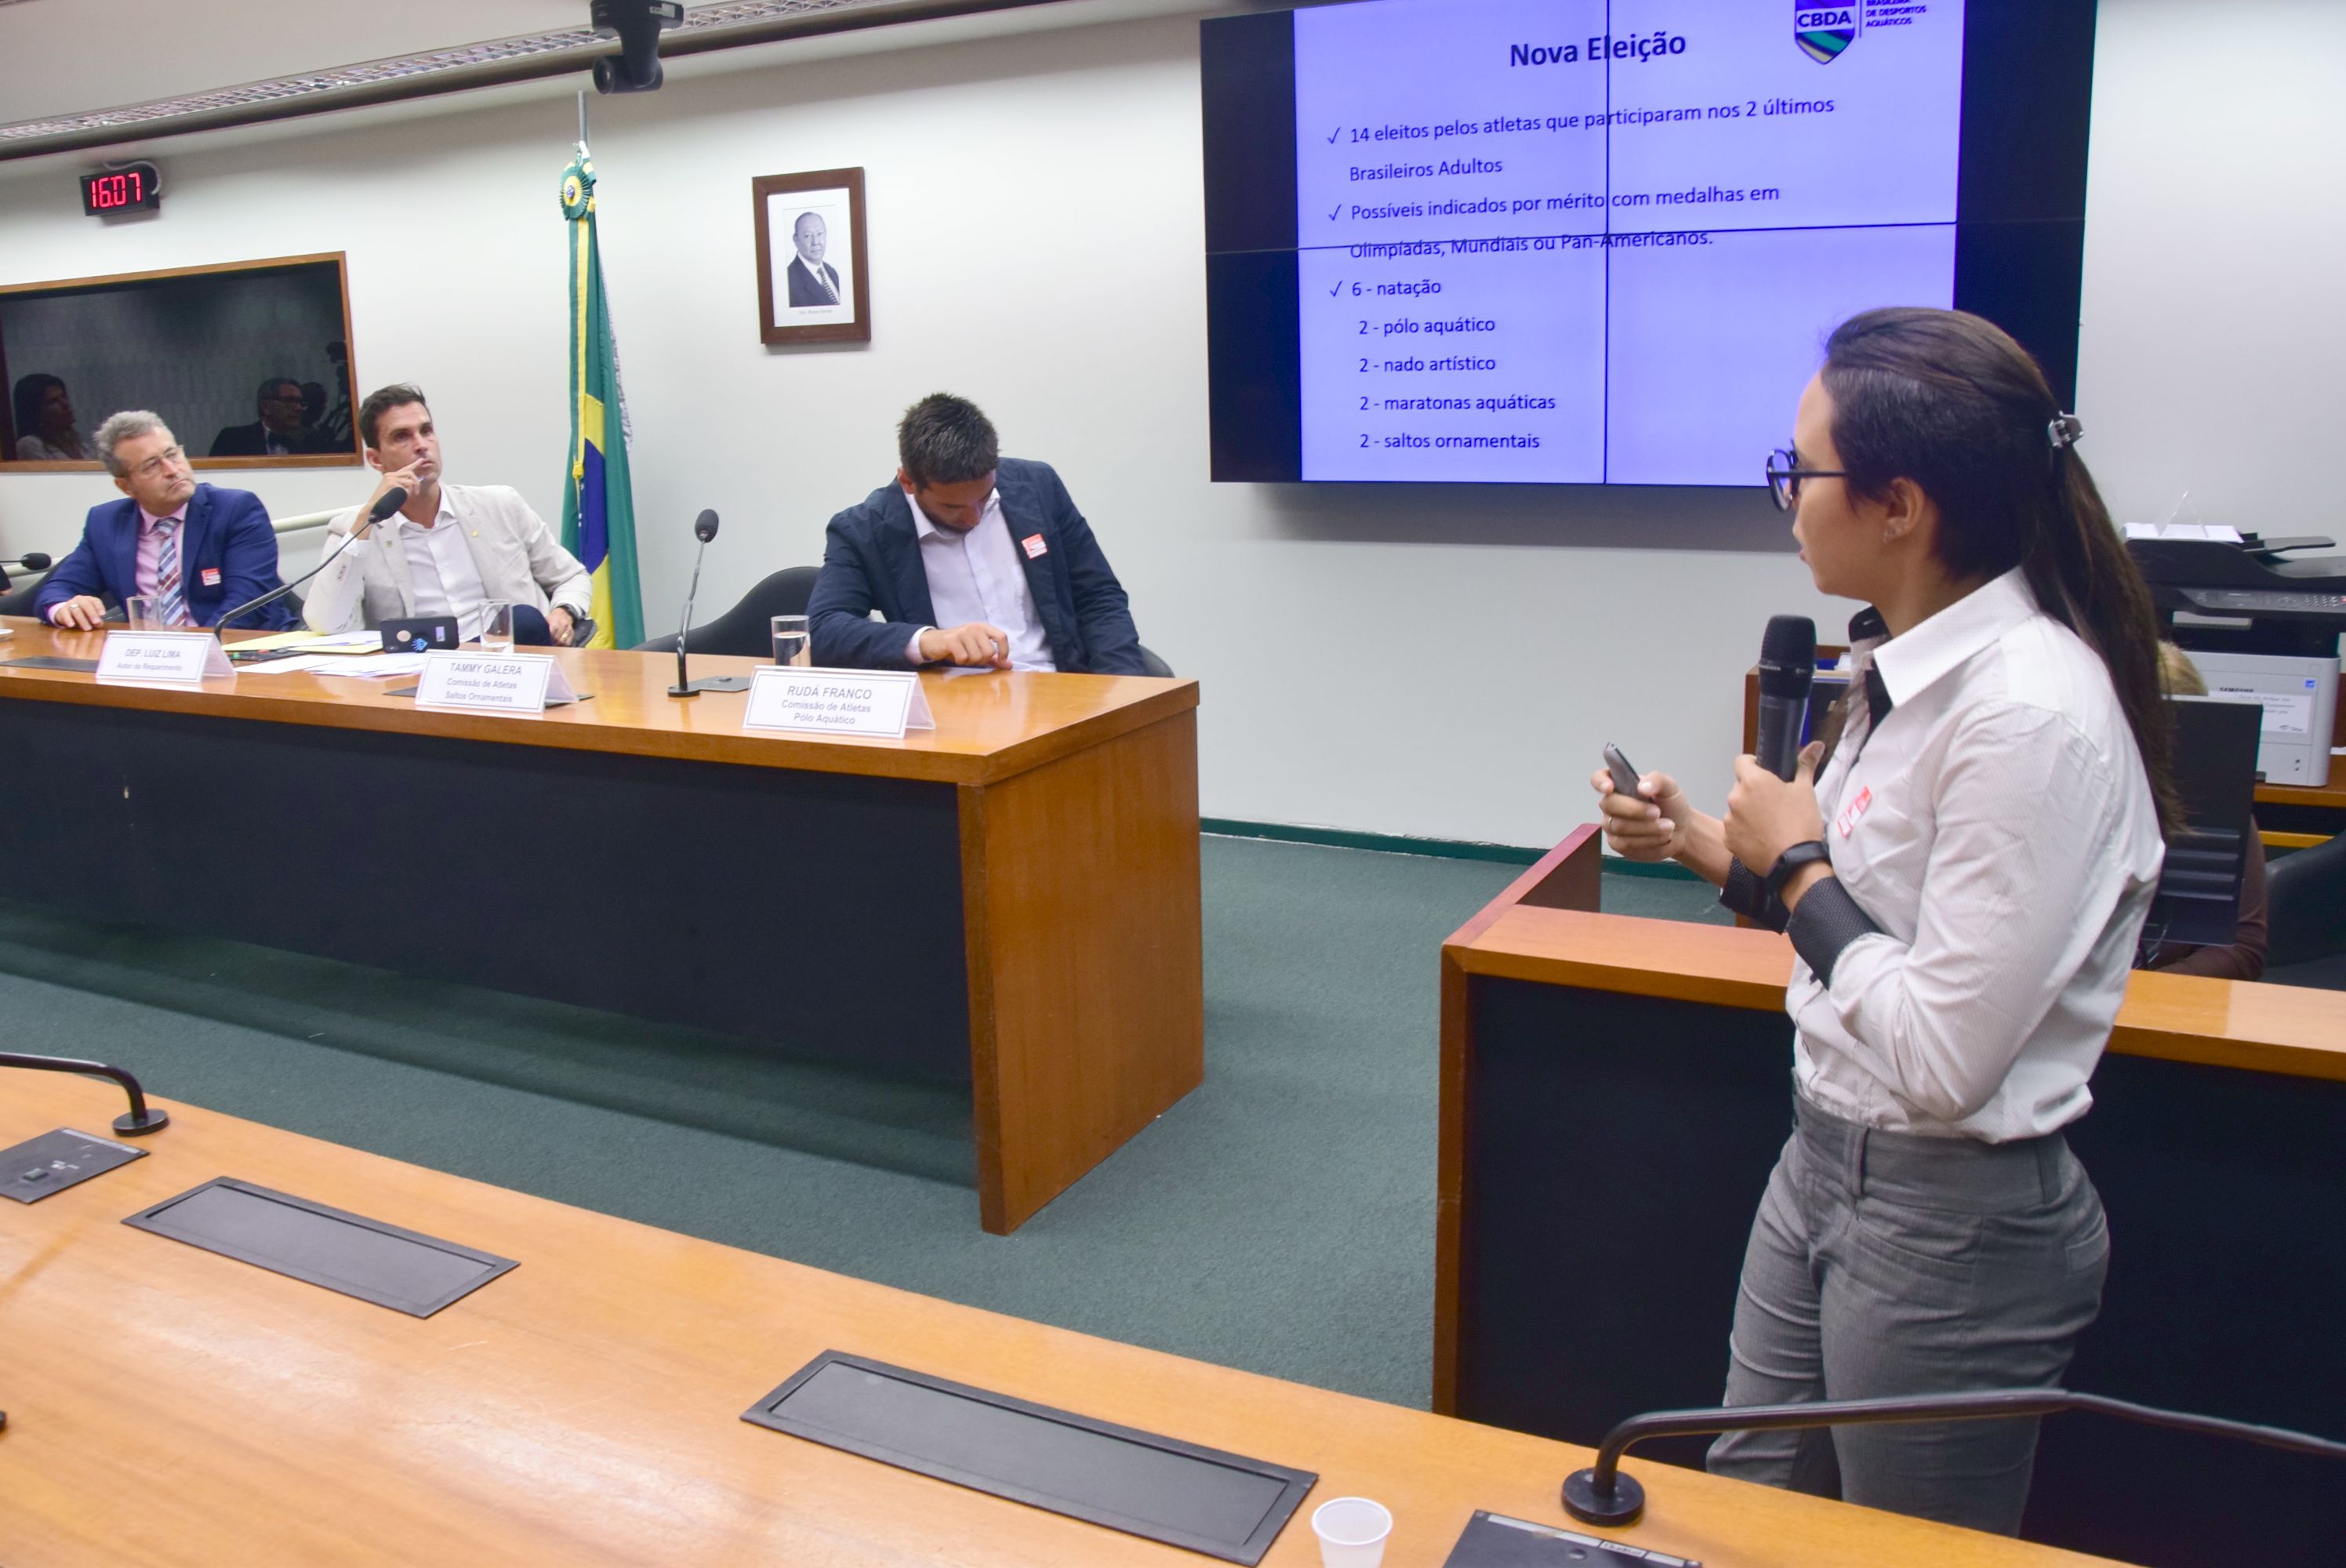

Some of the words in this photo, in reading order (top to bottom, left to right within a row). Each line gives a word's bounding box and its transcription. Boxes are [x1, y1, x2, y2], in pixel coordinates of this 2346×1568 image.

[1797, 10, 1851, 27] CBDA
[1510, 43, 1578, 67] Nova
[1588, 31, 1686, 63] Eleição
[1350, 128, 1369, 143] 14
[1375, 125, 1429, 142] eleitos
[1434, 119, 1478, 140] pelos
[1483, 116, 1541, 133] atletas
[1546, 115, 1578, 132] que
[1585, 107, 1701, 130] participaram
[1708, 104, 1740, 119] nos
[1746, 100, 1756, 117] 2
[1763, 98, 1834, 116] últimos
[1350, 163, 1433, 182] Brasileiros
[1438, 158, 1502, 176] Adultos
[1351, 202, 1423, 220] Possíveis
[1428, 197, 1507, 216] indicados
[1513, 196, 1542, 215] por
[1547, 193, 1604, 210] mérito
[1611, 193, 1650, 207] com
[1656, 186, 1745, 205] medalhas
[1749, 187, 1779, 201] em
[1350, 240, 1446, 260] Olimpíadas,
[1451, 236, 1528, 255] Mundiais
[1534, 237, 1556, 251] ou
[1561, 230, 1713, 250] Pan-Americanos.
[1352, 281, 1361, 296] 6
[1377, 278, 1441, 298] natação
[1359, 320, 1368, 335] 2
[1384, 318, 1419, 337] pólo
[1424, 317, 1495, 336] aquático
[1359, 358, 1368, 372] 2
[1384, 355, 1424, 372] nado
[1429, 355, 1496, 371] artístico
[1360, 396, 1368, 410] 2
[1384, 397, 1470, 410] maratonas
[1476, 394, 1556, 413] aquáticas
[1360, 434, 1369, 448] 2
[1384, 433, 1430, 448] saltos
[1435, 434, 1540, 448] ornamentais
[144, 649, 162, 658] LUIZ
[162, 650, 180, 659] LIMA
[450, 662, 482, 673] TAMMY
[484, 664, 522, 675] GALERA
[447, 677, 480, 688] Comissão
[493, 680, 518, 689] Atletas
[445, 691, 467, 700] Saltos
[468, 692, 513, 702] Ornamentais
[786, 684, 819, 697] RUDÁ
[822, 687, 872, 700] FRANCO
[782, 699, 824, 710] Comissão
[826, 702, 837, 711] de
[840, 702, 871, 713] Atletas
[816, 714, 855, 725] Aquático
